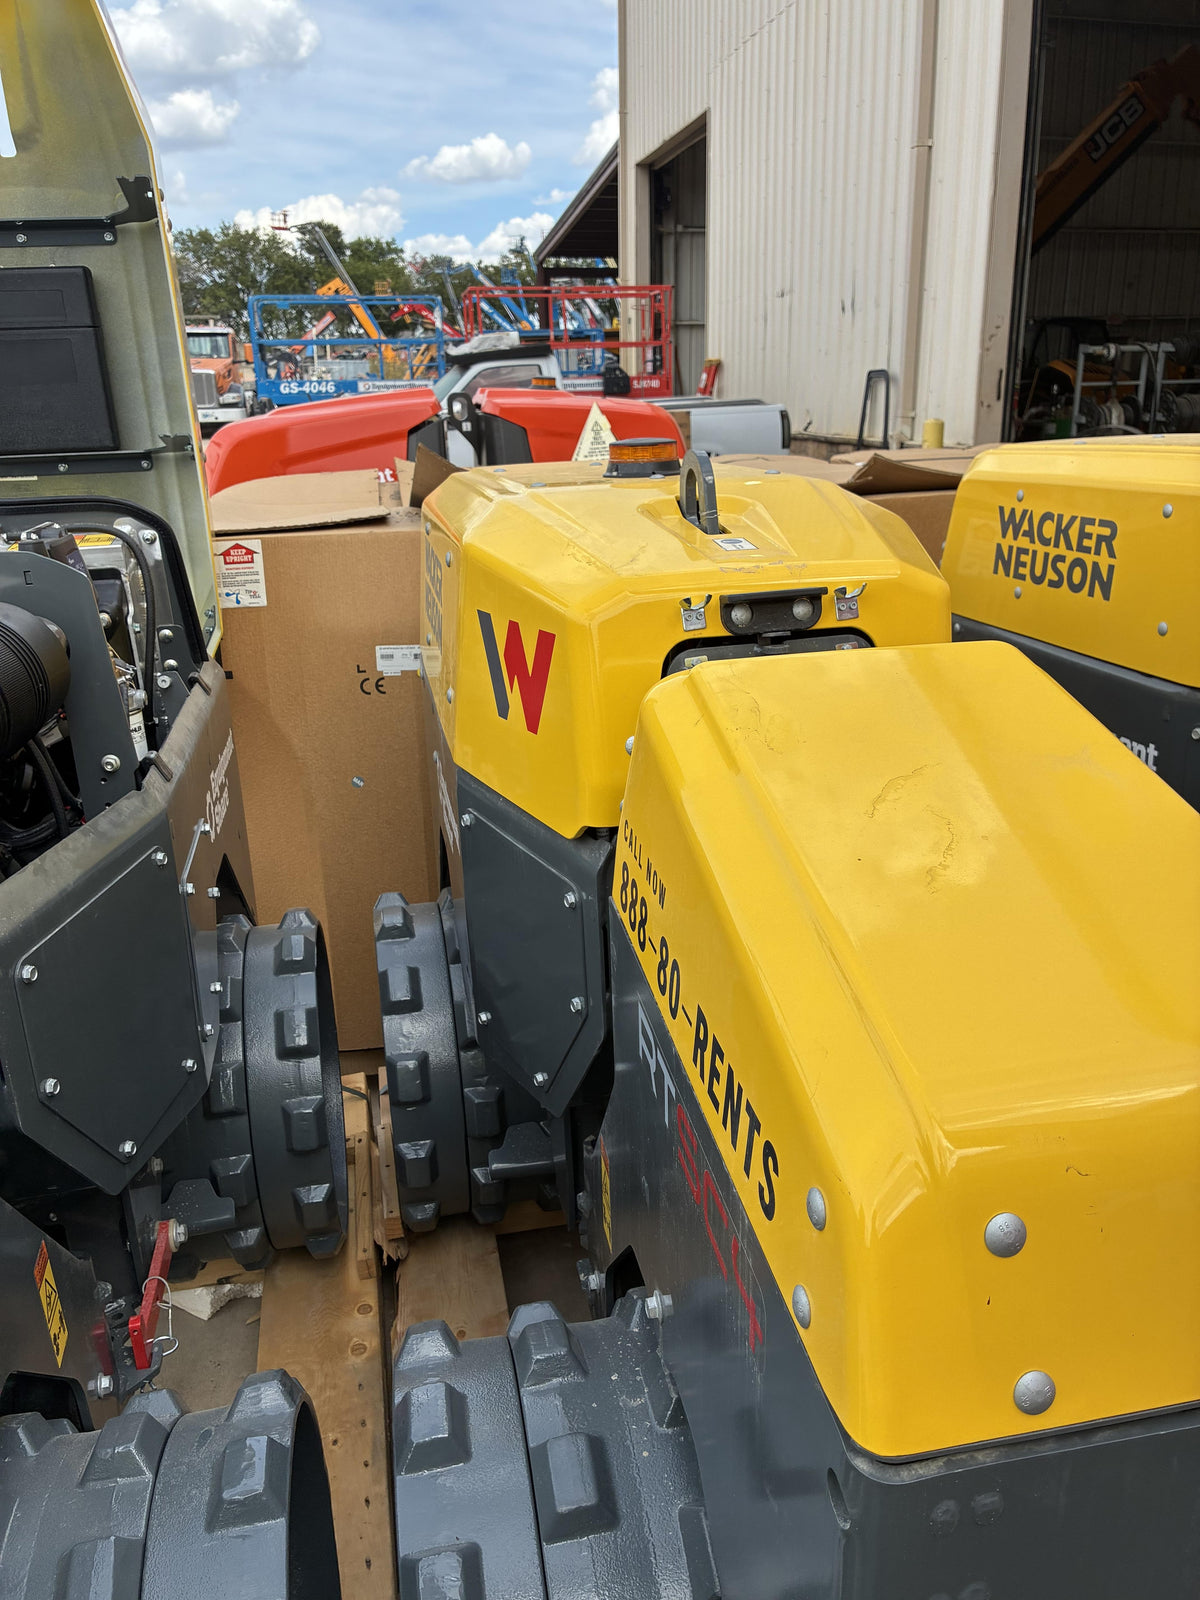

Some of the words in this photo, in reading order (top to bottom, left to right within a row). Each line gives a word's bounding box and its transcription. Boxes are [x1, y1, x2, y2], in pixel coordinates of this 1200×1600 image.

[1089, 97, 1145, 161] JCB
[279, 381, 336, 395] GS-4046
[998, 505, 1118, 560] WACKER
[993, 543, 1115, 602] NEUSON
[623, 819, 643, 870] CALL
[646, 857, 667, 910] NOW
[620, 860, 780, 1222] 888-80-RENTS
